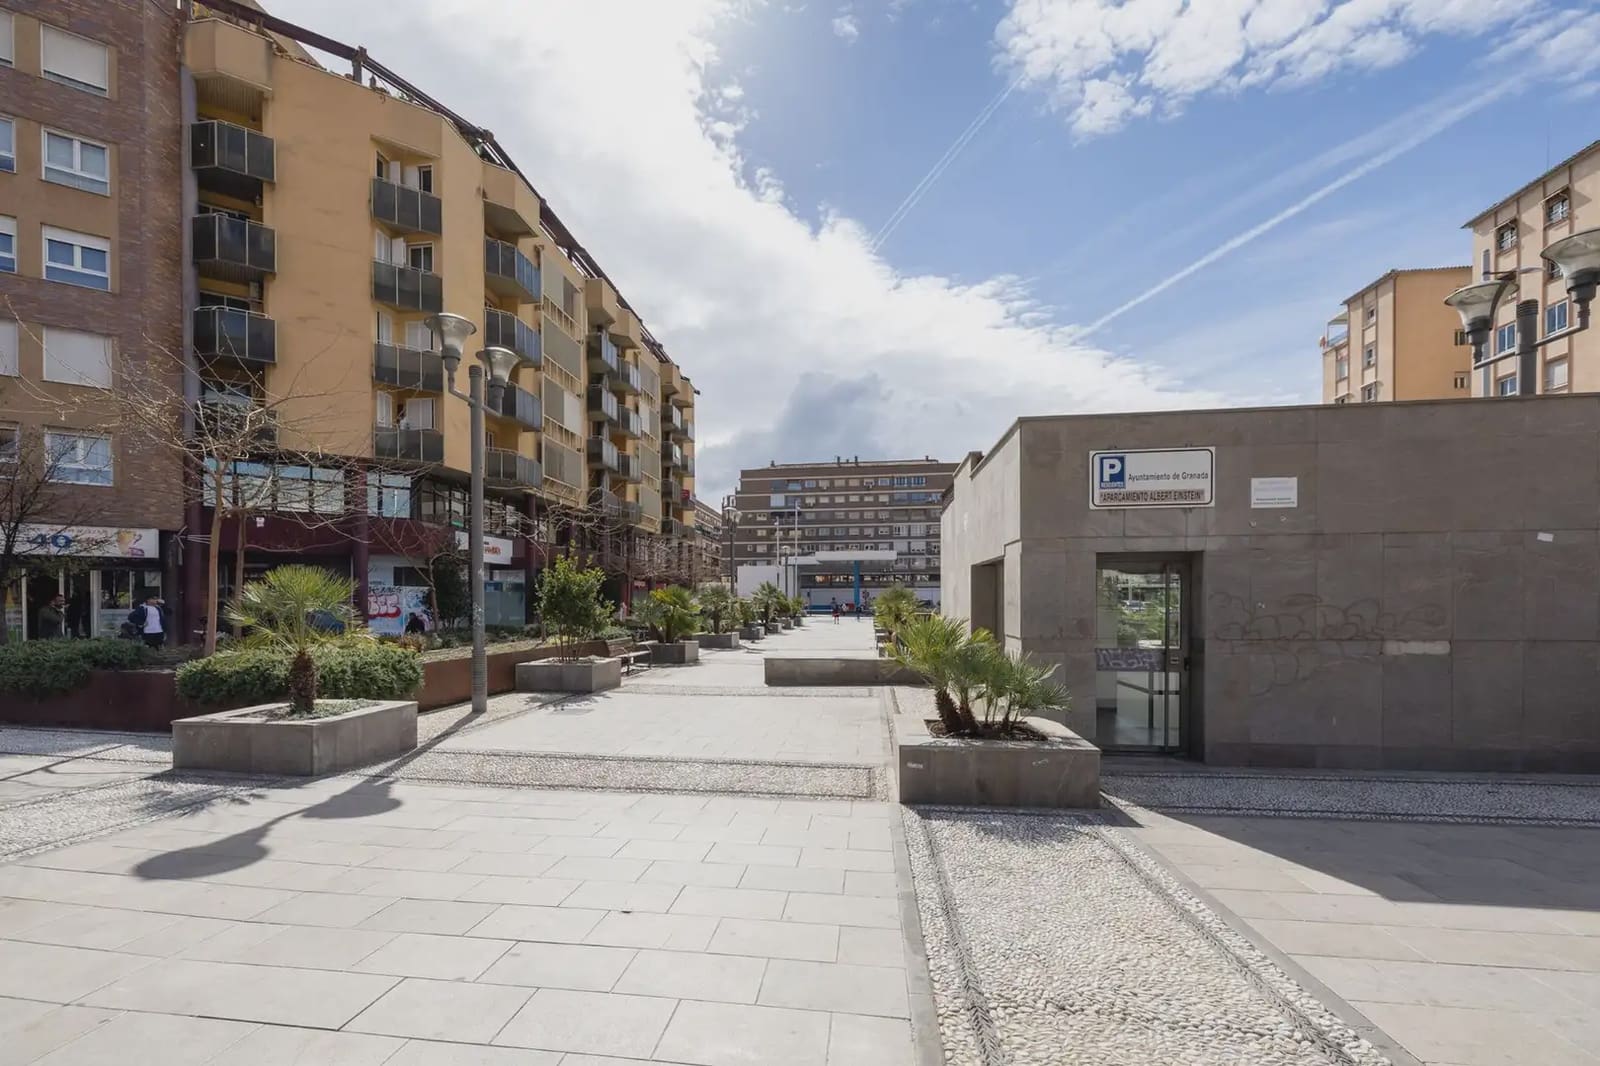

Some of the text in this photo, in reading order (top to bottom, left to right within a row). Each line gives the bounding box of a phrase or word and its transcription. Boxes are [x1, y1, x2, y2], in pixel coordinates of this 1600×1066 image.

[1103, 458, 1121, 482] P
[1128, 471, 1208, 482] Ayuntamiento de Granada
[1150, 491, 1172, 502] ALBERT
